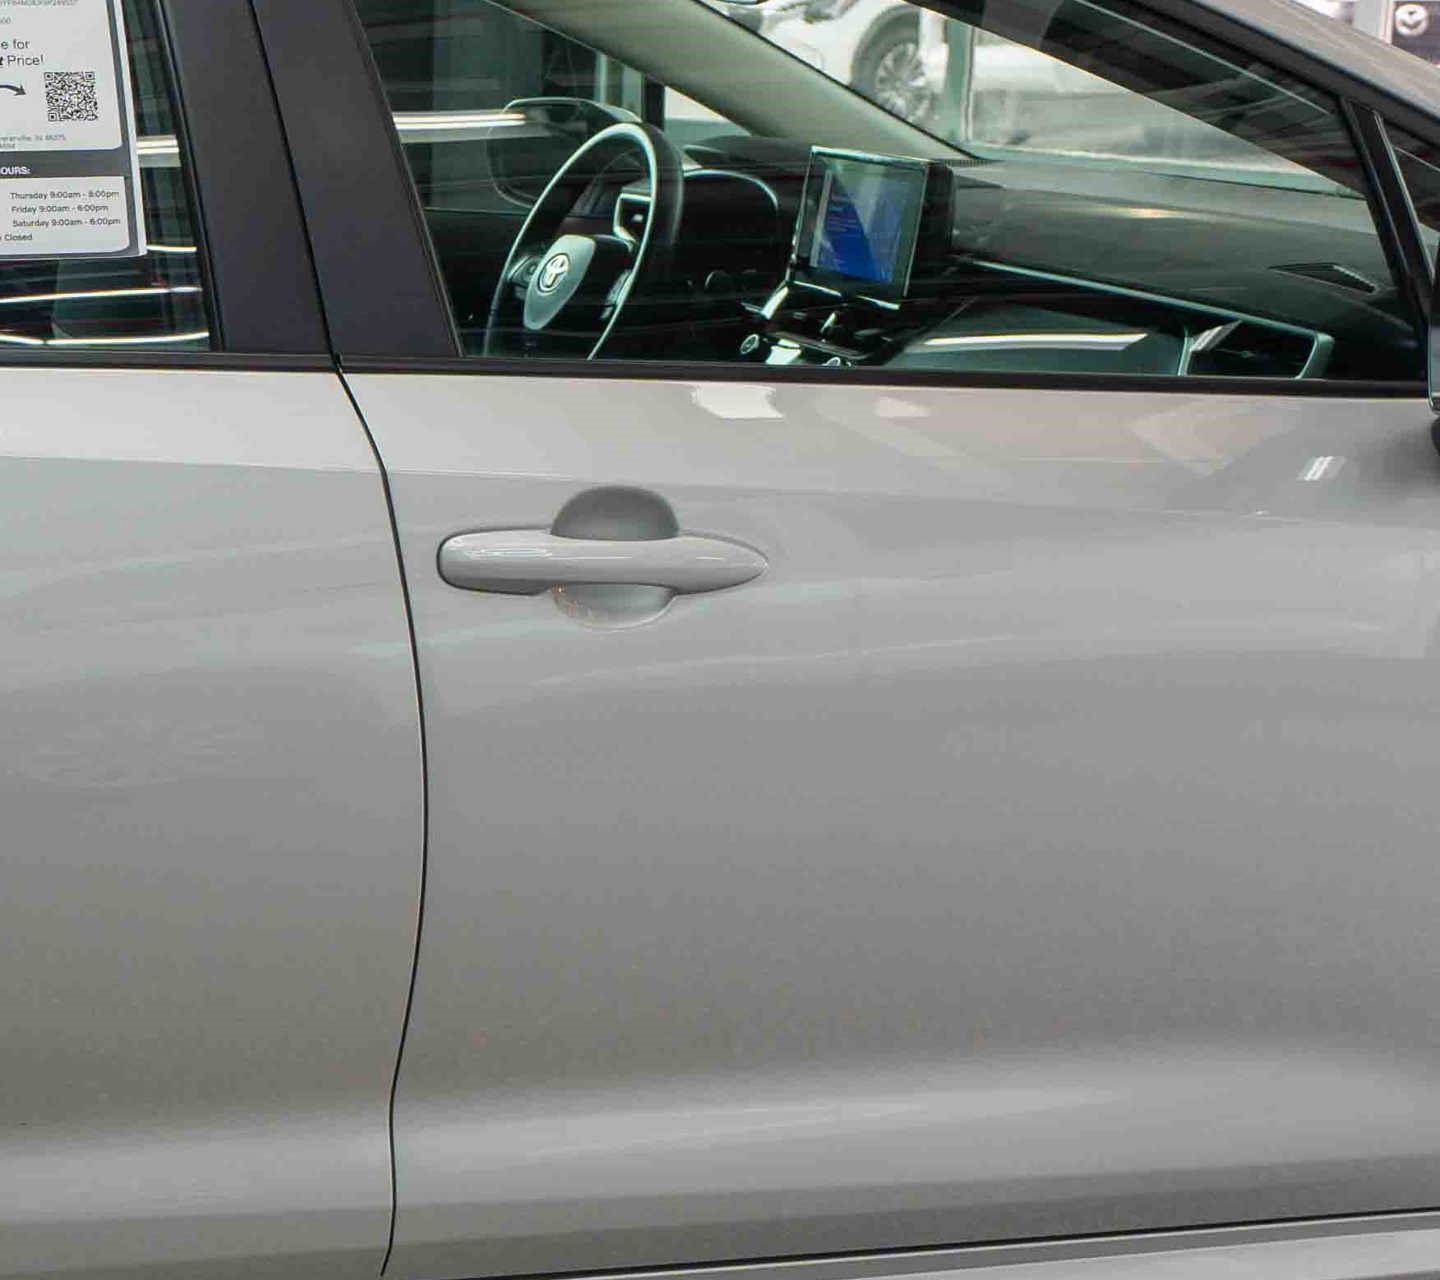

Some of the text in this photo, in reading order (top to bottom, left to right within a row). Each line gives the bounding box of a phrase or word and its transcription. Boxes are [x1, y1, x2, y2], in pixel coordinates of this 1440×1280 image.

[13, 39, 30, 49] for
[7, 55, 44, 66] Price!
[11, 192, 47, 200] Thursday
[50, 191, 80, 199] 9:00am
[11, 206, 37, 214] Friday
[13, 219, 49, 228] Saturday
[5, 233, 33, 241] Closed
